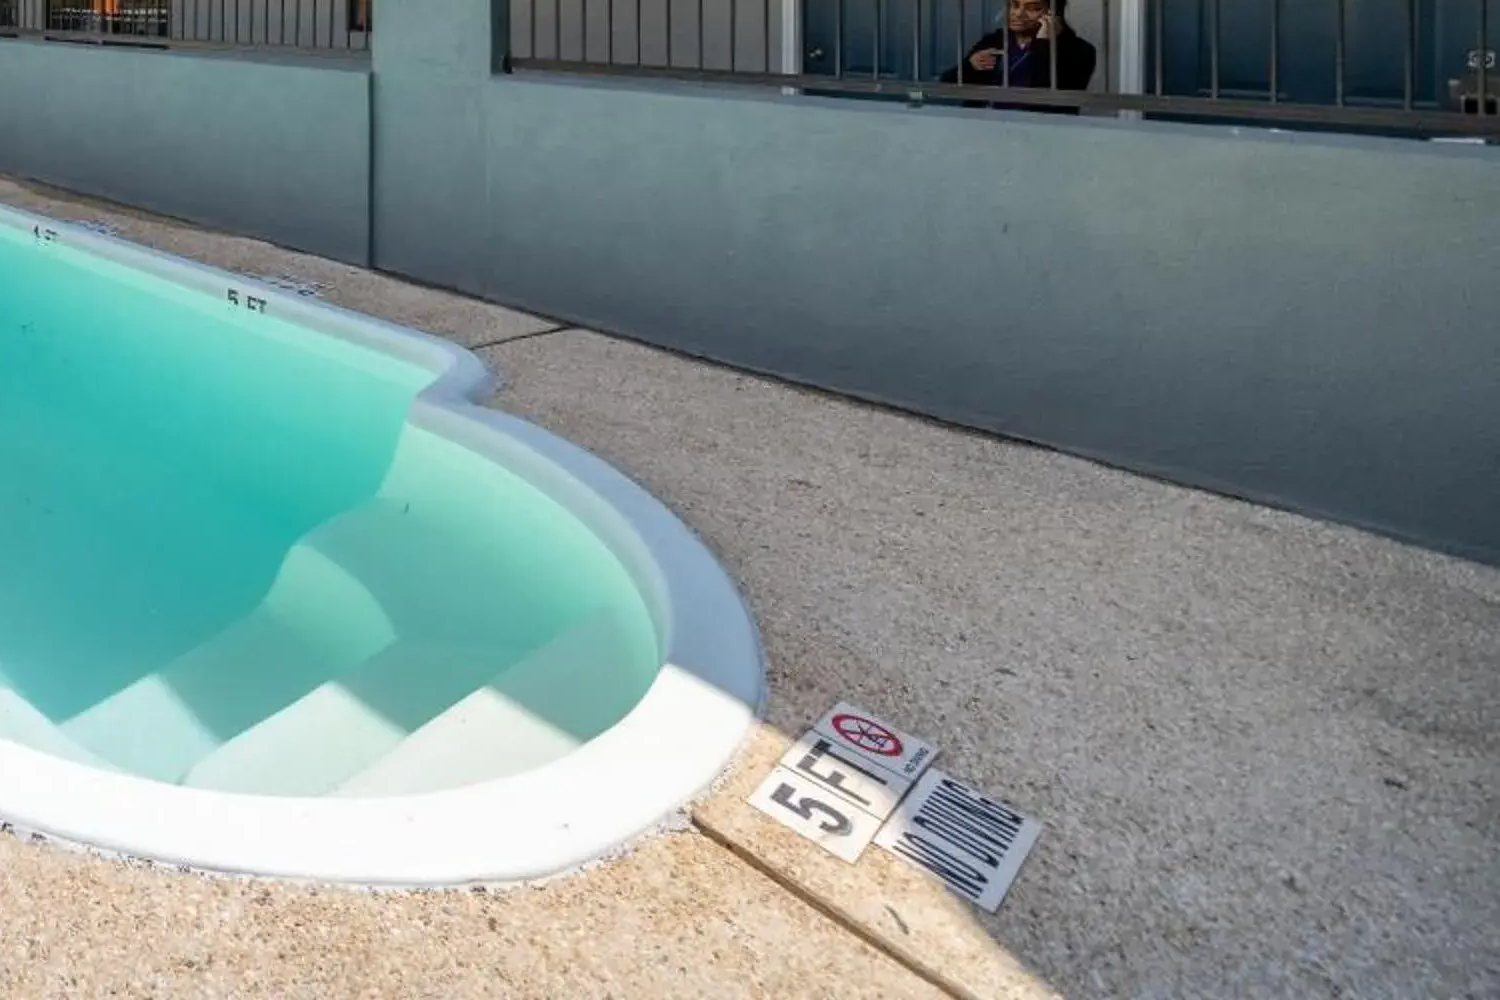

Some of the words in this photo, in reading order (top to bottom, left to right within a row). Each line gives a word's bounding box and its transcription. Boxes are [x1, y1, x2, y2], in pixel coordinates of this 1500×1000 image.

[796, 739, 888, 806] FT
[769, 782, 853, 836] 5
[912, 778, 1024, 868] DIVING
[892, 832, 989, 899] NO
